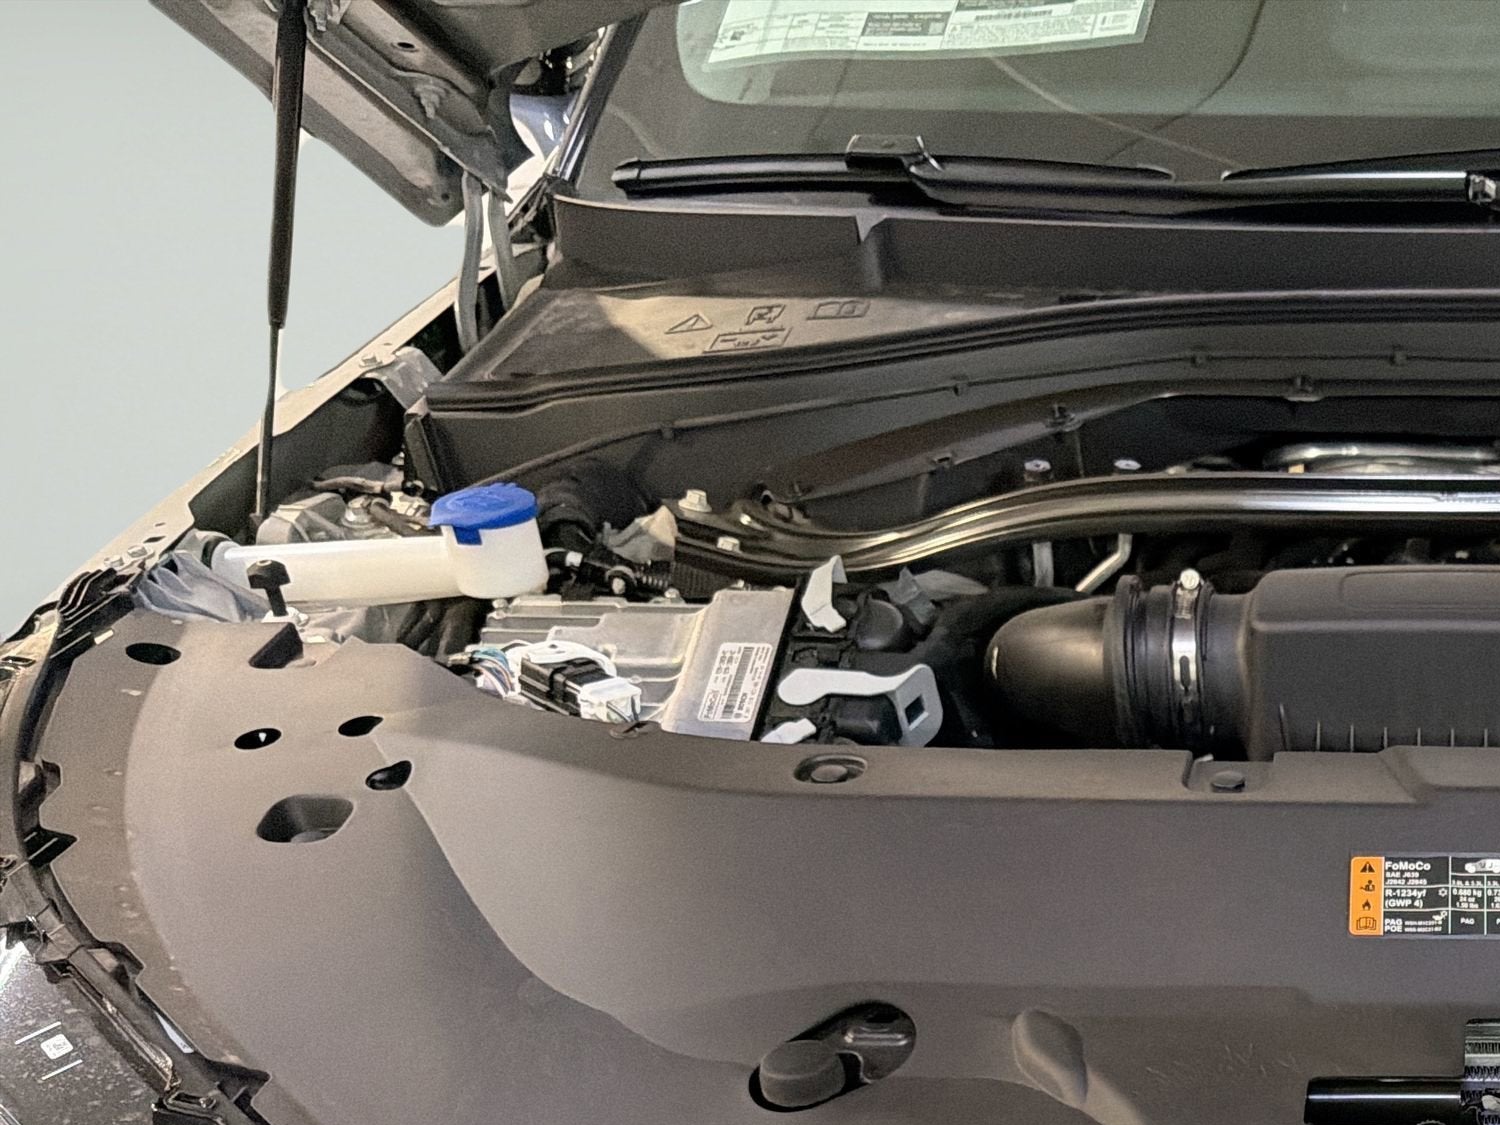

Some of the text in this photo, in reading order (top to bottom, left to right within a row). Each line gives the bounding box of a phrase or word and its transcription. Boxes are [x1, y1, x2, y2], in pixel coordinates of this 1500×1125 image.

[1385, 861, 1431, 871] FoMoCo
[1385, 889, 1427, 898] R-1234yf
[1473, 889, 1482, 897] kg
[1385, 899, 1423, 908] (GWP 4)
